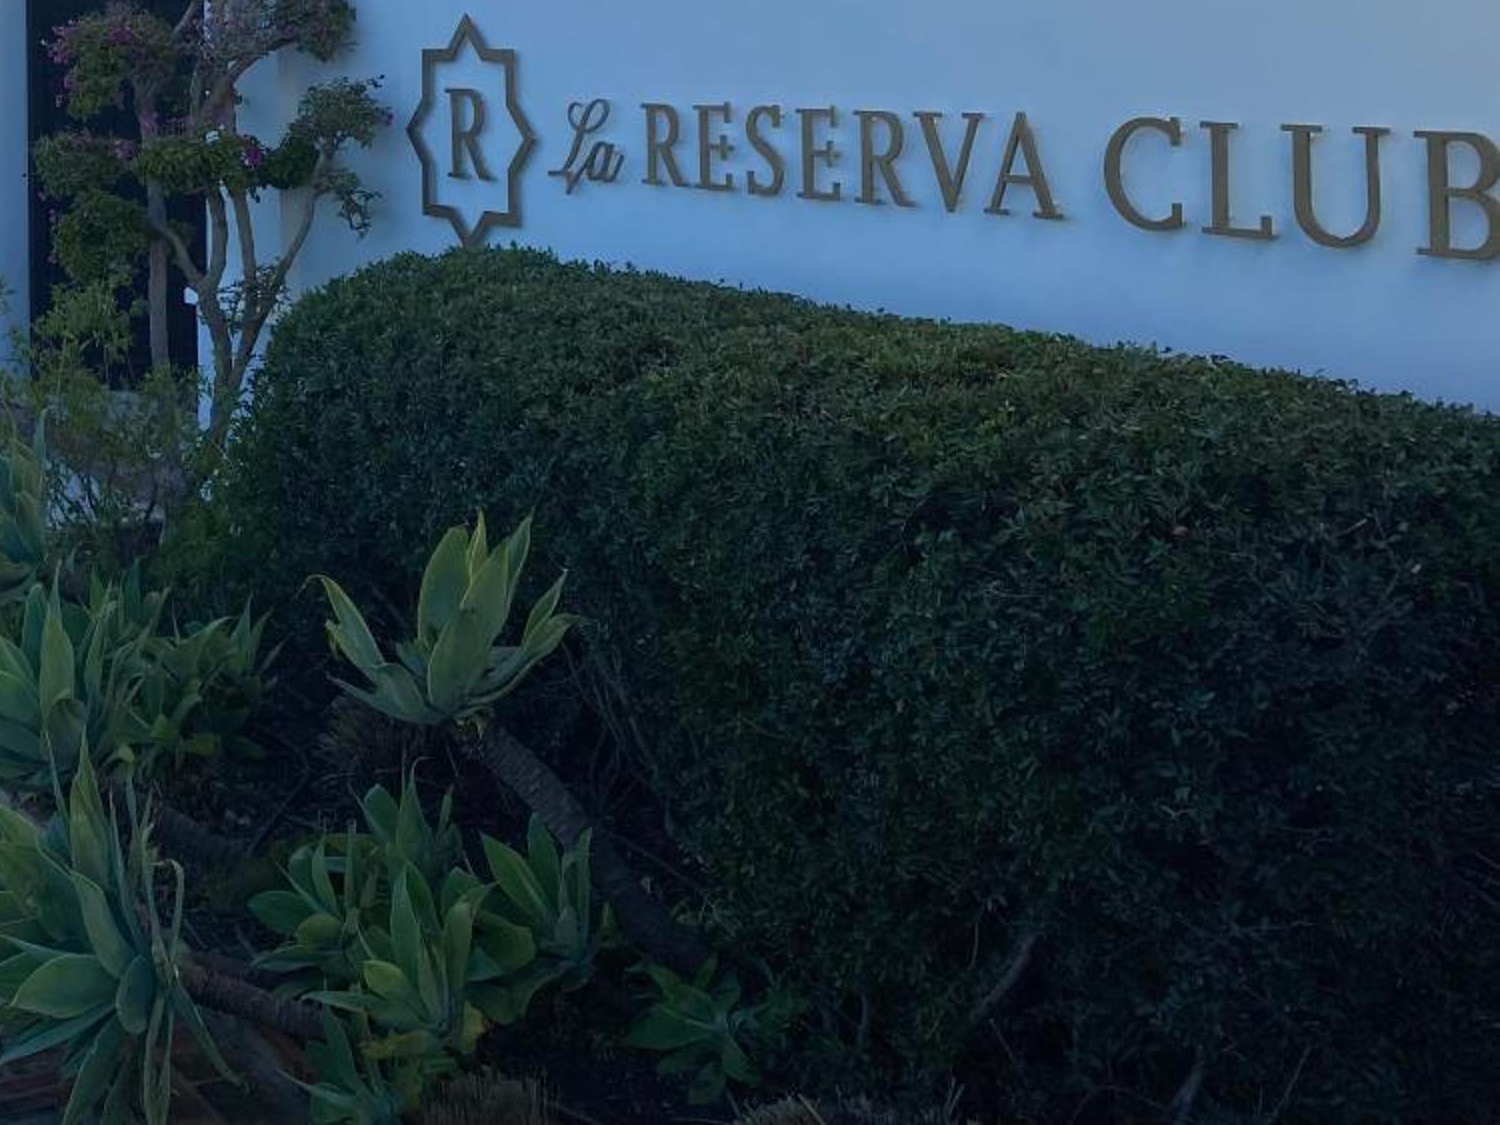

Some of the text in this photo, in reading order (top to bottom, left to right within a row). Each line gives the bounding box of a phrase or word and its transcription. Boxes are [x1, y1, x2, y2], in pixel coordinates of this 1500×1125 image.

[445, 88, 496, 181] R
[548, 98, 1500, 261] La RESERVA CLUB
